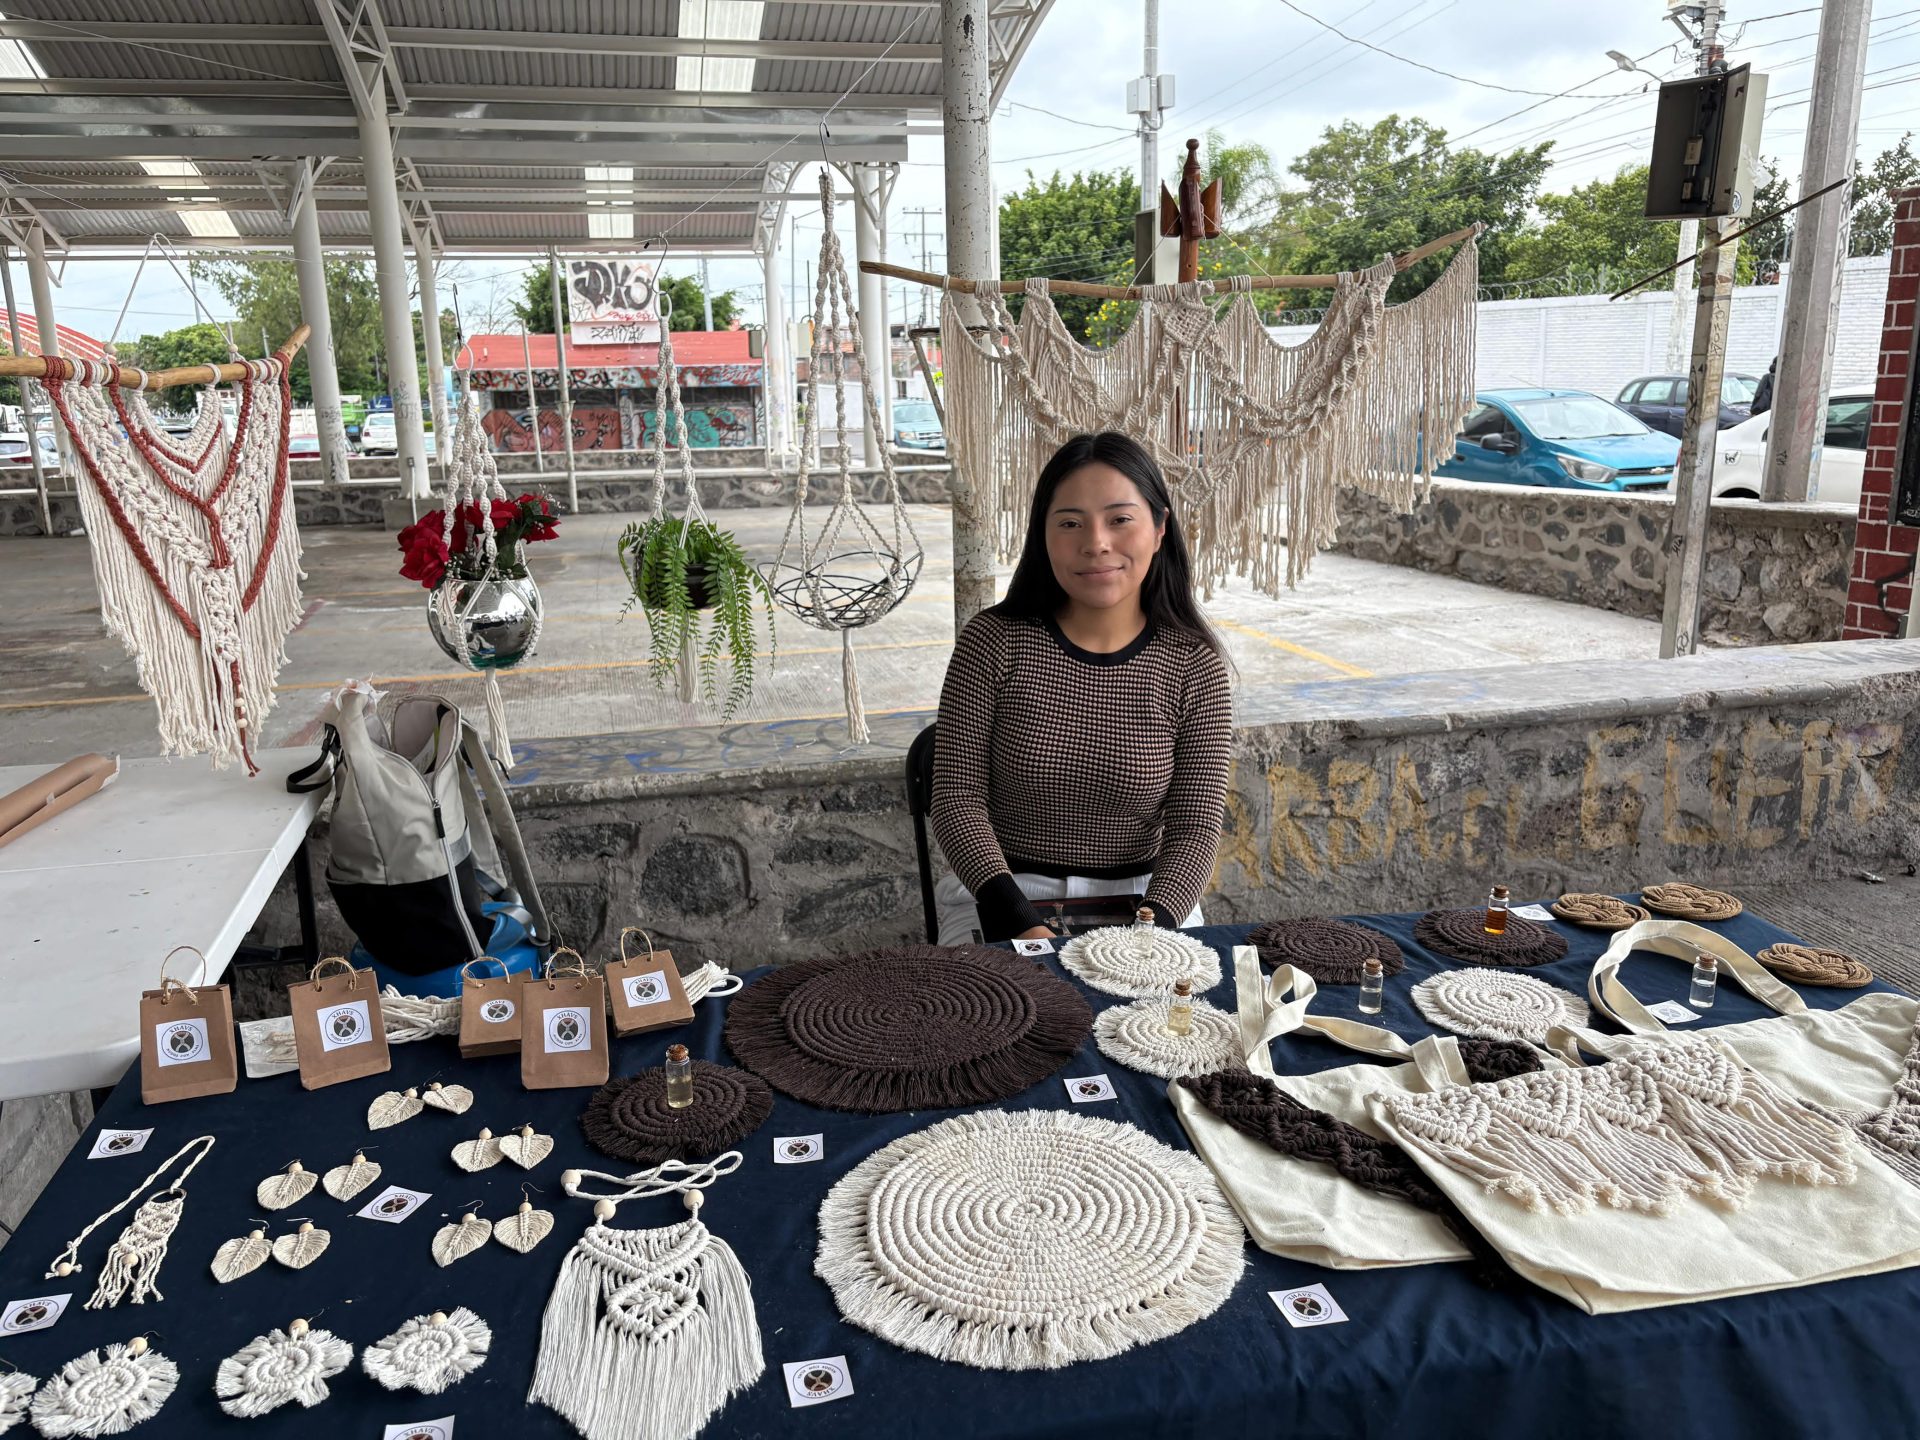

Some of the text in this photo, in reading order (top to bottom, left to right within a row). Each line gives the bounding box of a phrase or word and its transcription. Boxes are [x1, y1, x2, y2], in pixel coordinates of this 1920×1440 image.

[332, 1010, 354, 1019] XHAVS
[557, 1012, 578, 1020] XHAVS
[169, 1025, 192, 1033] XHAVS
[1287, 1292, 1312, 1301] XHAVS
[806, 1386, 836, 1397] XHAVS
